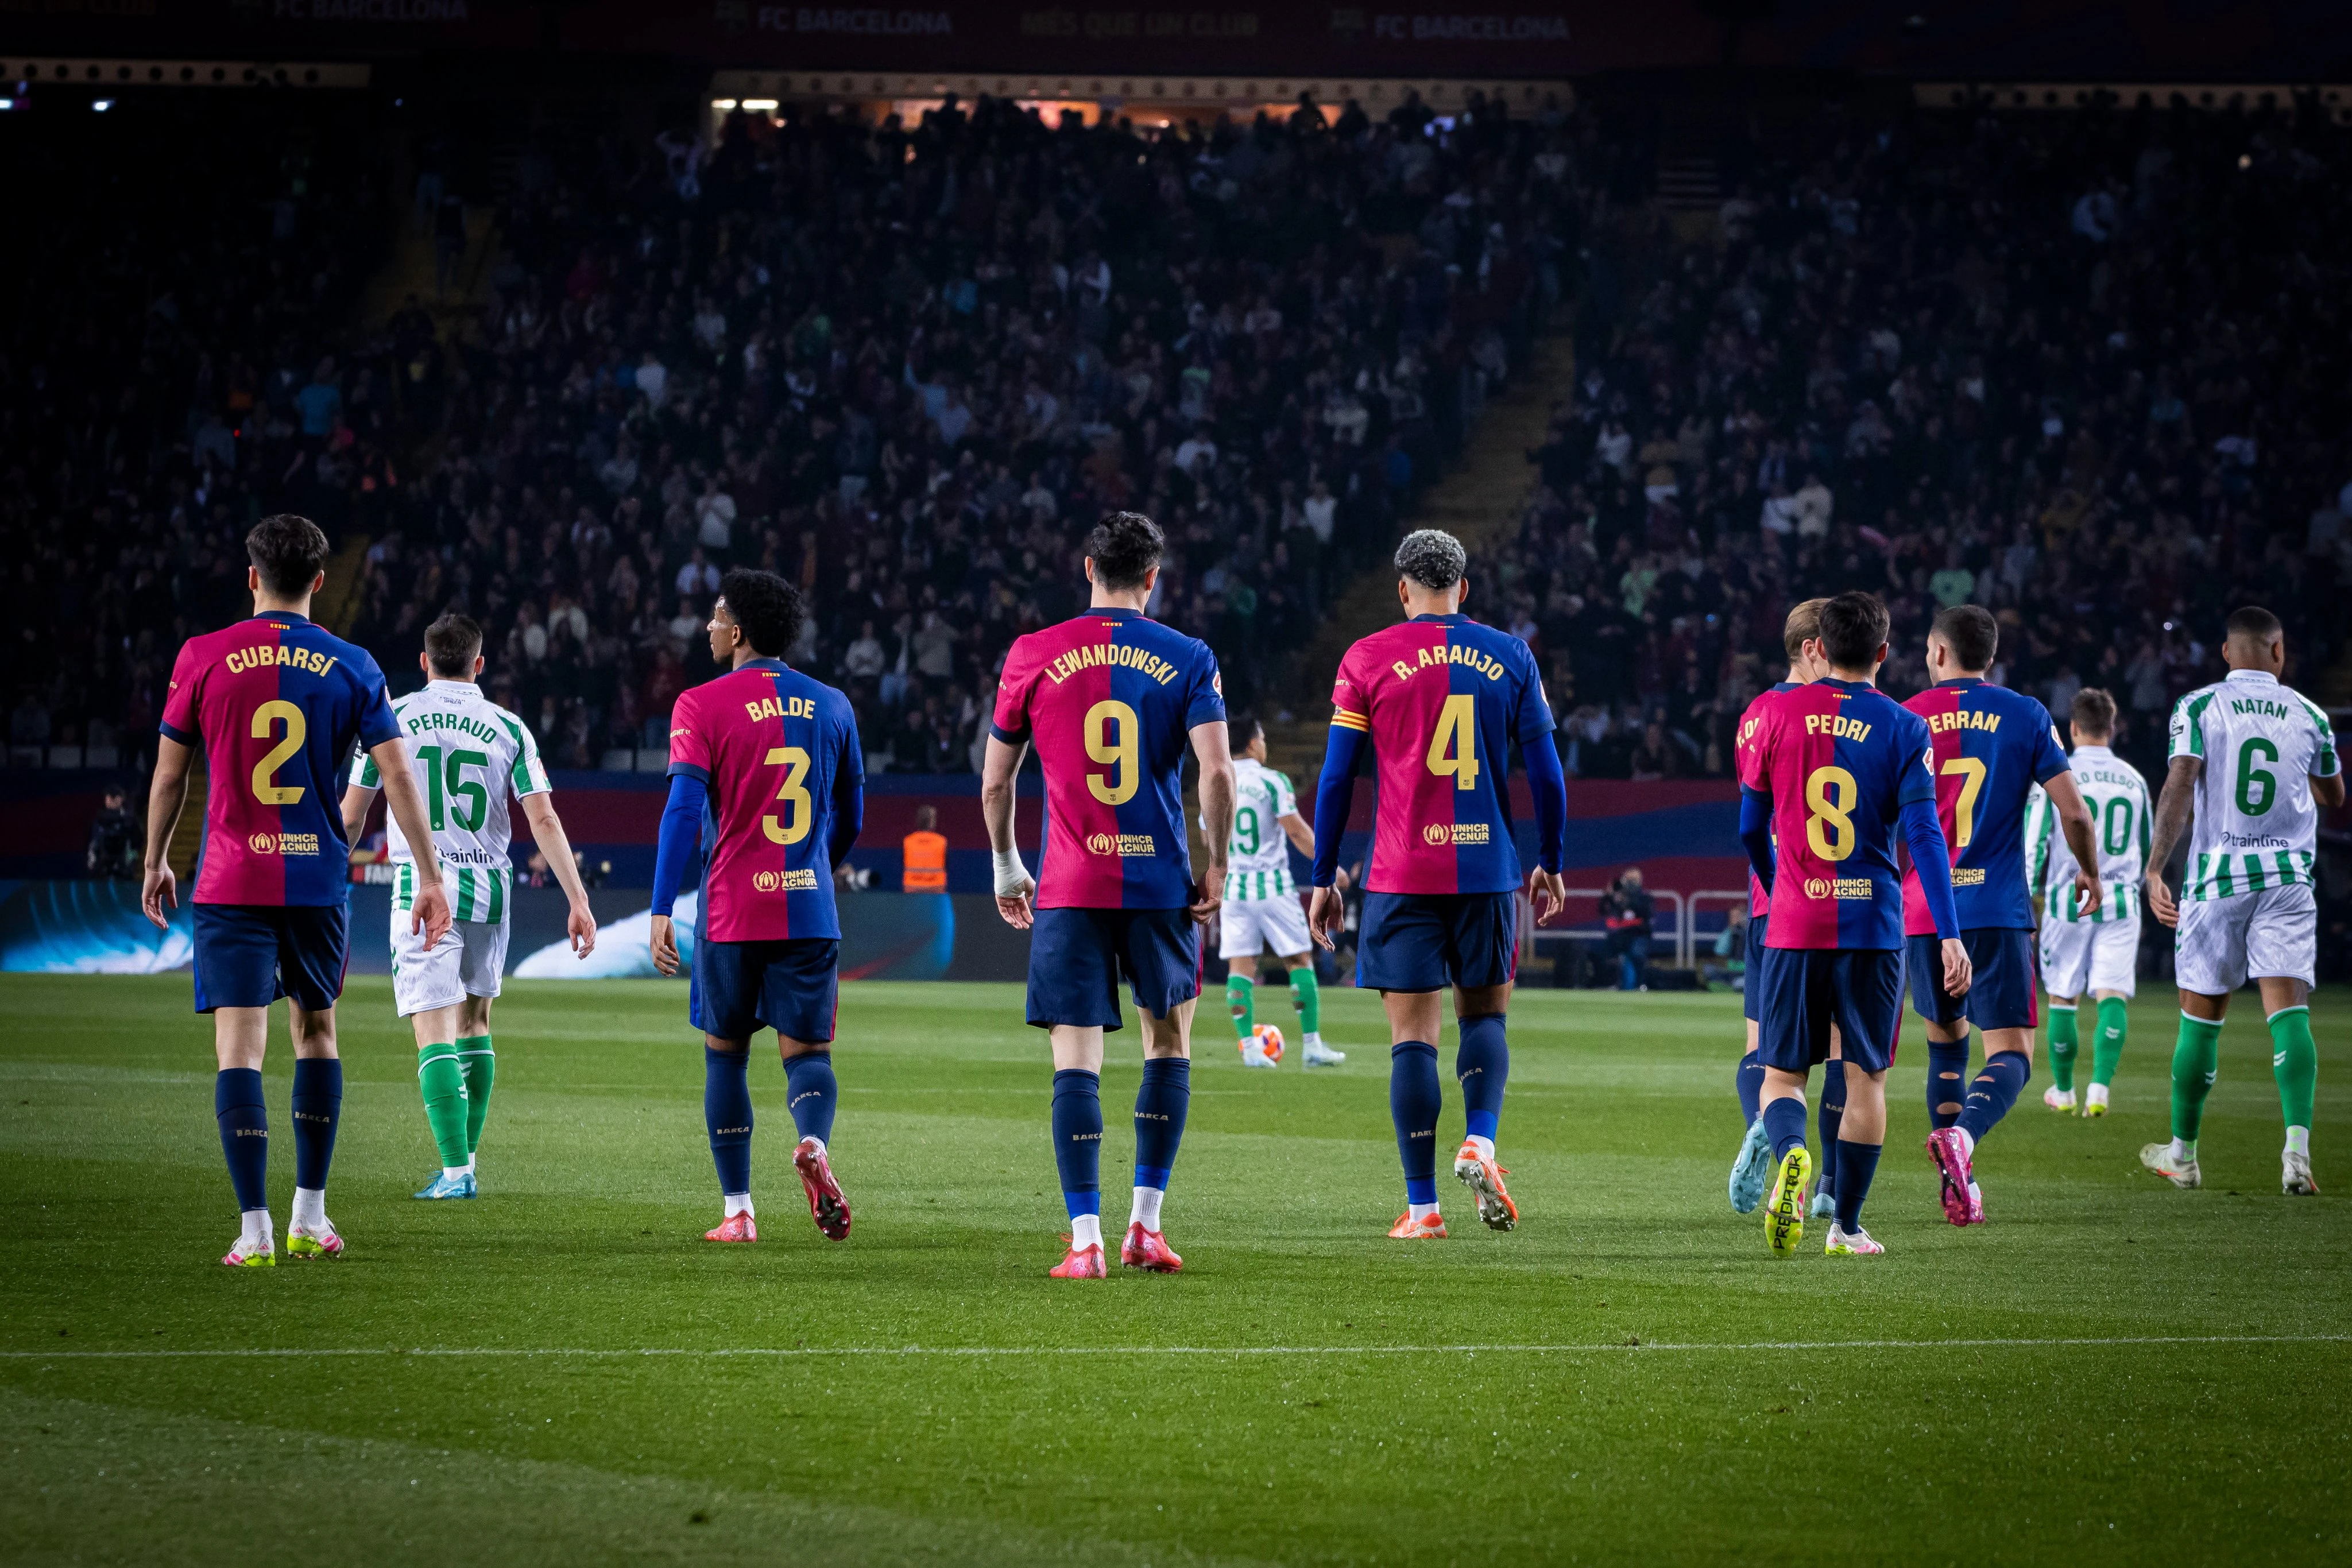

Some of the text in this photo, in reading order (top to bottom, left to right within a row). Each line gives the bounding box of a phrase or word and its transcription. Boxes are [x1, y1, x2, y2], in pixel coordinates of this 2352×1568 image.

[311, 0, 469, 20] BARCELONA
[758, 6, 952, 34] FC BARCELONA
[1375, 14, 1571, 40] FC BARCELONA
[226, 646, 339, 677] CUBARSÍ
[1045, 644, 1178, 686] LEWANDOWSKI
[1392, 645, 1504, 680] R. ARAUJO
[745, 697, 815, 722] BALDE
[2231, 699, 2288, 720] NATAN
[407, 713, 497, 744] PERRAUD
[1805, 715, 1871, 742] PEDRI
[1924, 711, 2001, 734] ERRAN
[252, 700, 306, 805] 2
[1084, 700, 1139, 805] 9
[1427, 695, 1479, 790] 4
[415, 745, 489, 833] 15
[2094, 771, 2134, 789] CELSO
[2235, 737, 2279, 816] 6
[763, 748, 811, 845] 3
[1940, 757, 1986, 847] 7
[1806, 766, 1856, 861] 8
[2067, 795, 2133, 855] 0
[278, 834, 318, 842] UNHCR
[1115, 835, 1153, 843] UNHCR
[1229, 807, 1259, 855] 9
[1451, 824, 1488, 832] UNHCR
[1451, 833, 1489, 841] ACNUR
[2232, 833, 2289, 847] trainline
[279, 842, 319, 851] ACNUR
[1117, 843, 1155, 852] ACNUR
[781, 869, 815, 879] UNHCR
[782, 878, 817, 887] ACNUR
[1832, 879, 1872, 887] UNHCR
[1951, 868, 1985, 876] UNHCR
[1951, 874, 1984, 884] ACNUR
[1832, 887, 1872, 896] ACNUR
[1773, 1155, 1802, 1249] PREDATOR
